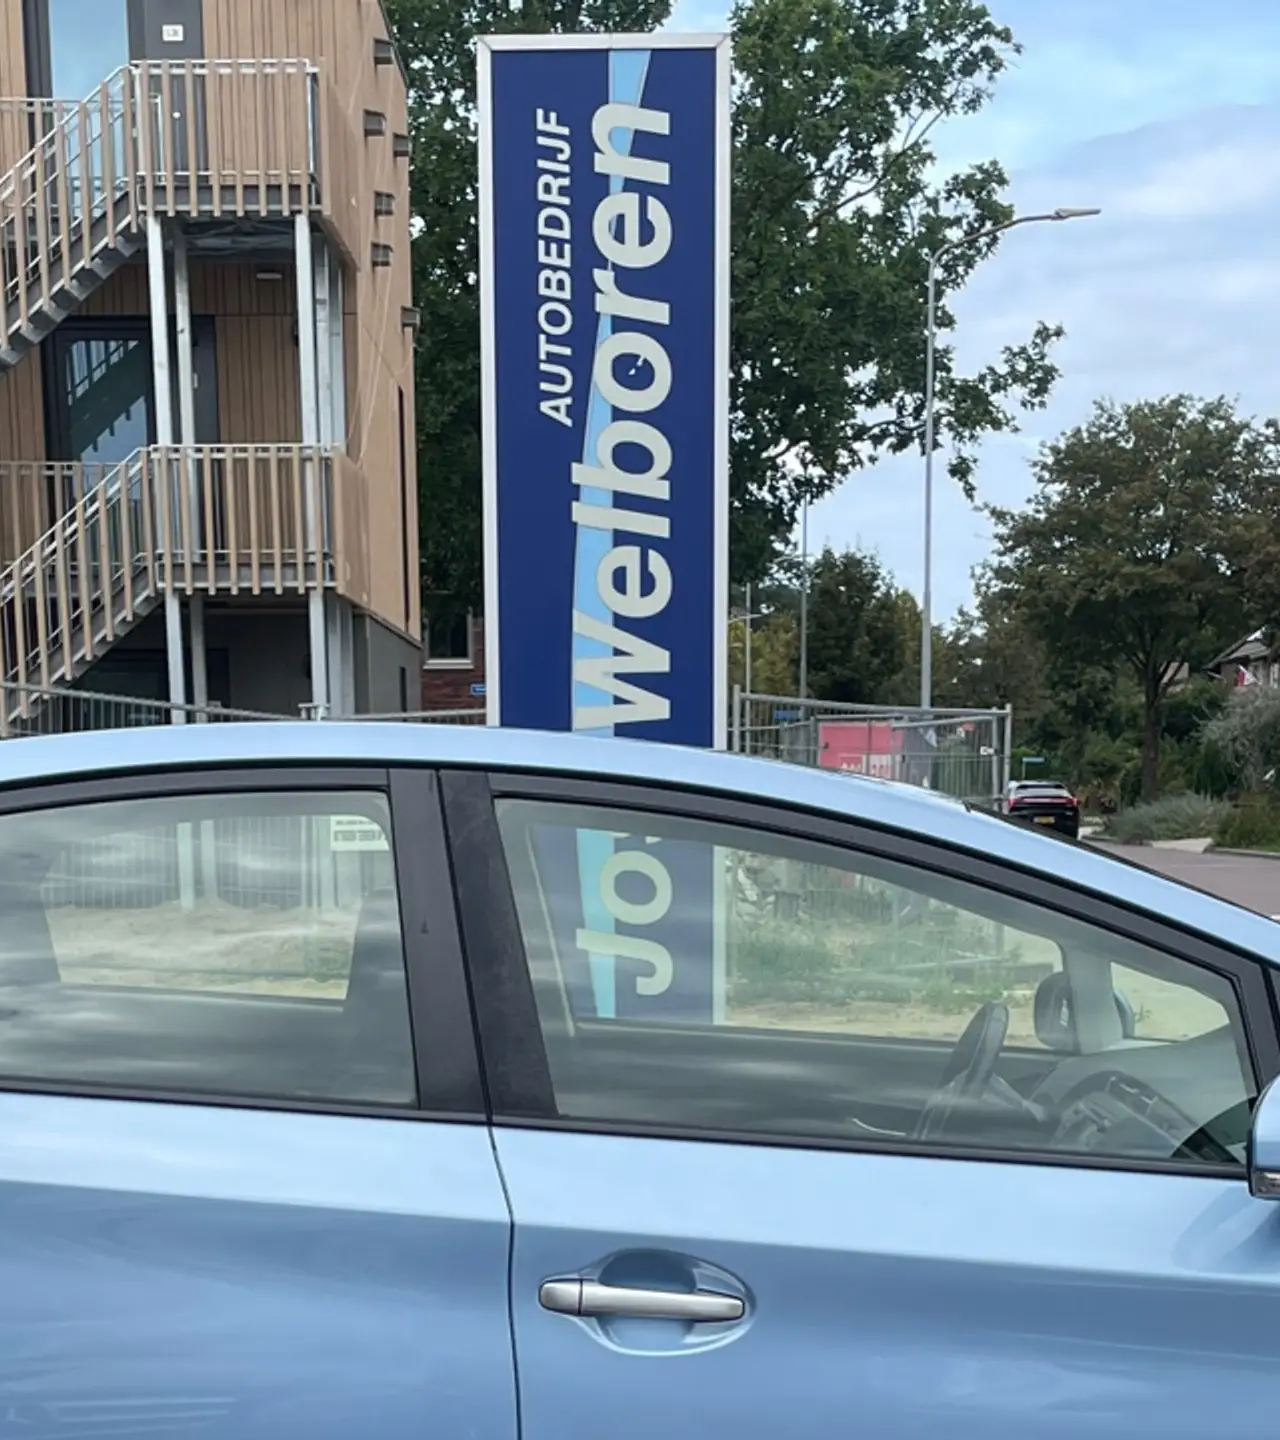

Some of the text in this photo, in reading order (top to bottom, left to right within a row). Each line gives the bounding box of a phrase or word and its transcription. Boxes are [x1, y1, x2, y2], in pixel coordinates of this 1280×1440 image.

[535, 107, 574, 428] AUTOBEDRIJF
[571, 101, 673, 995] Jo Welboren
